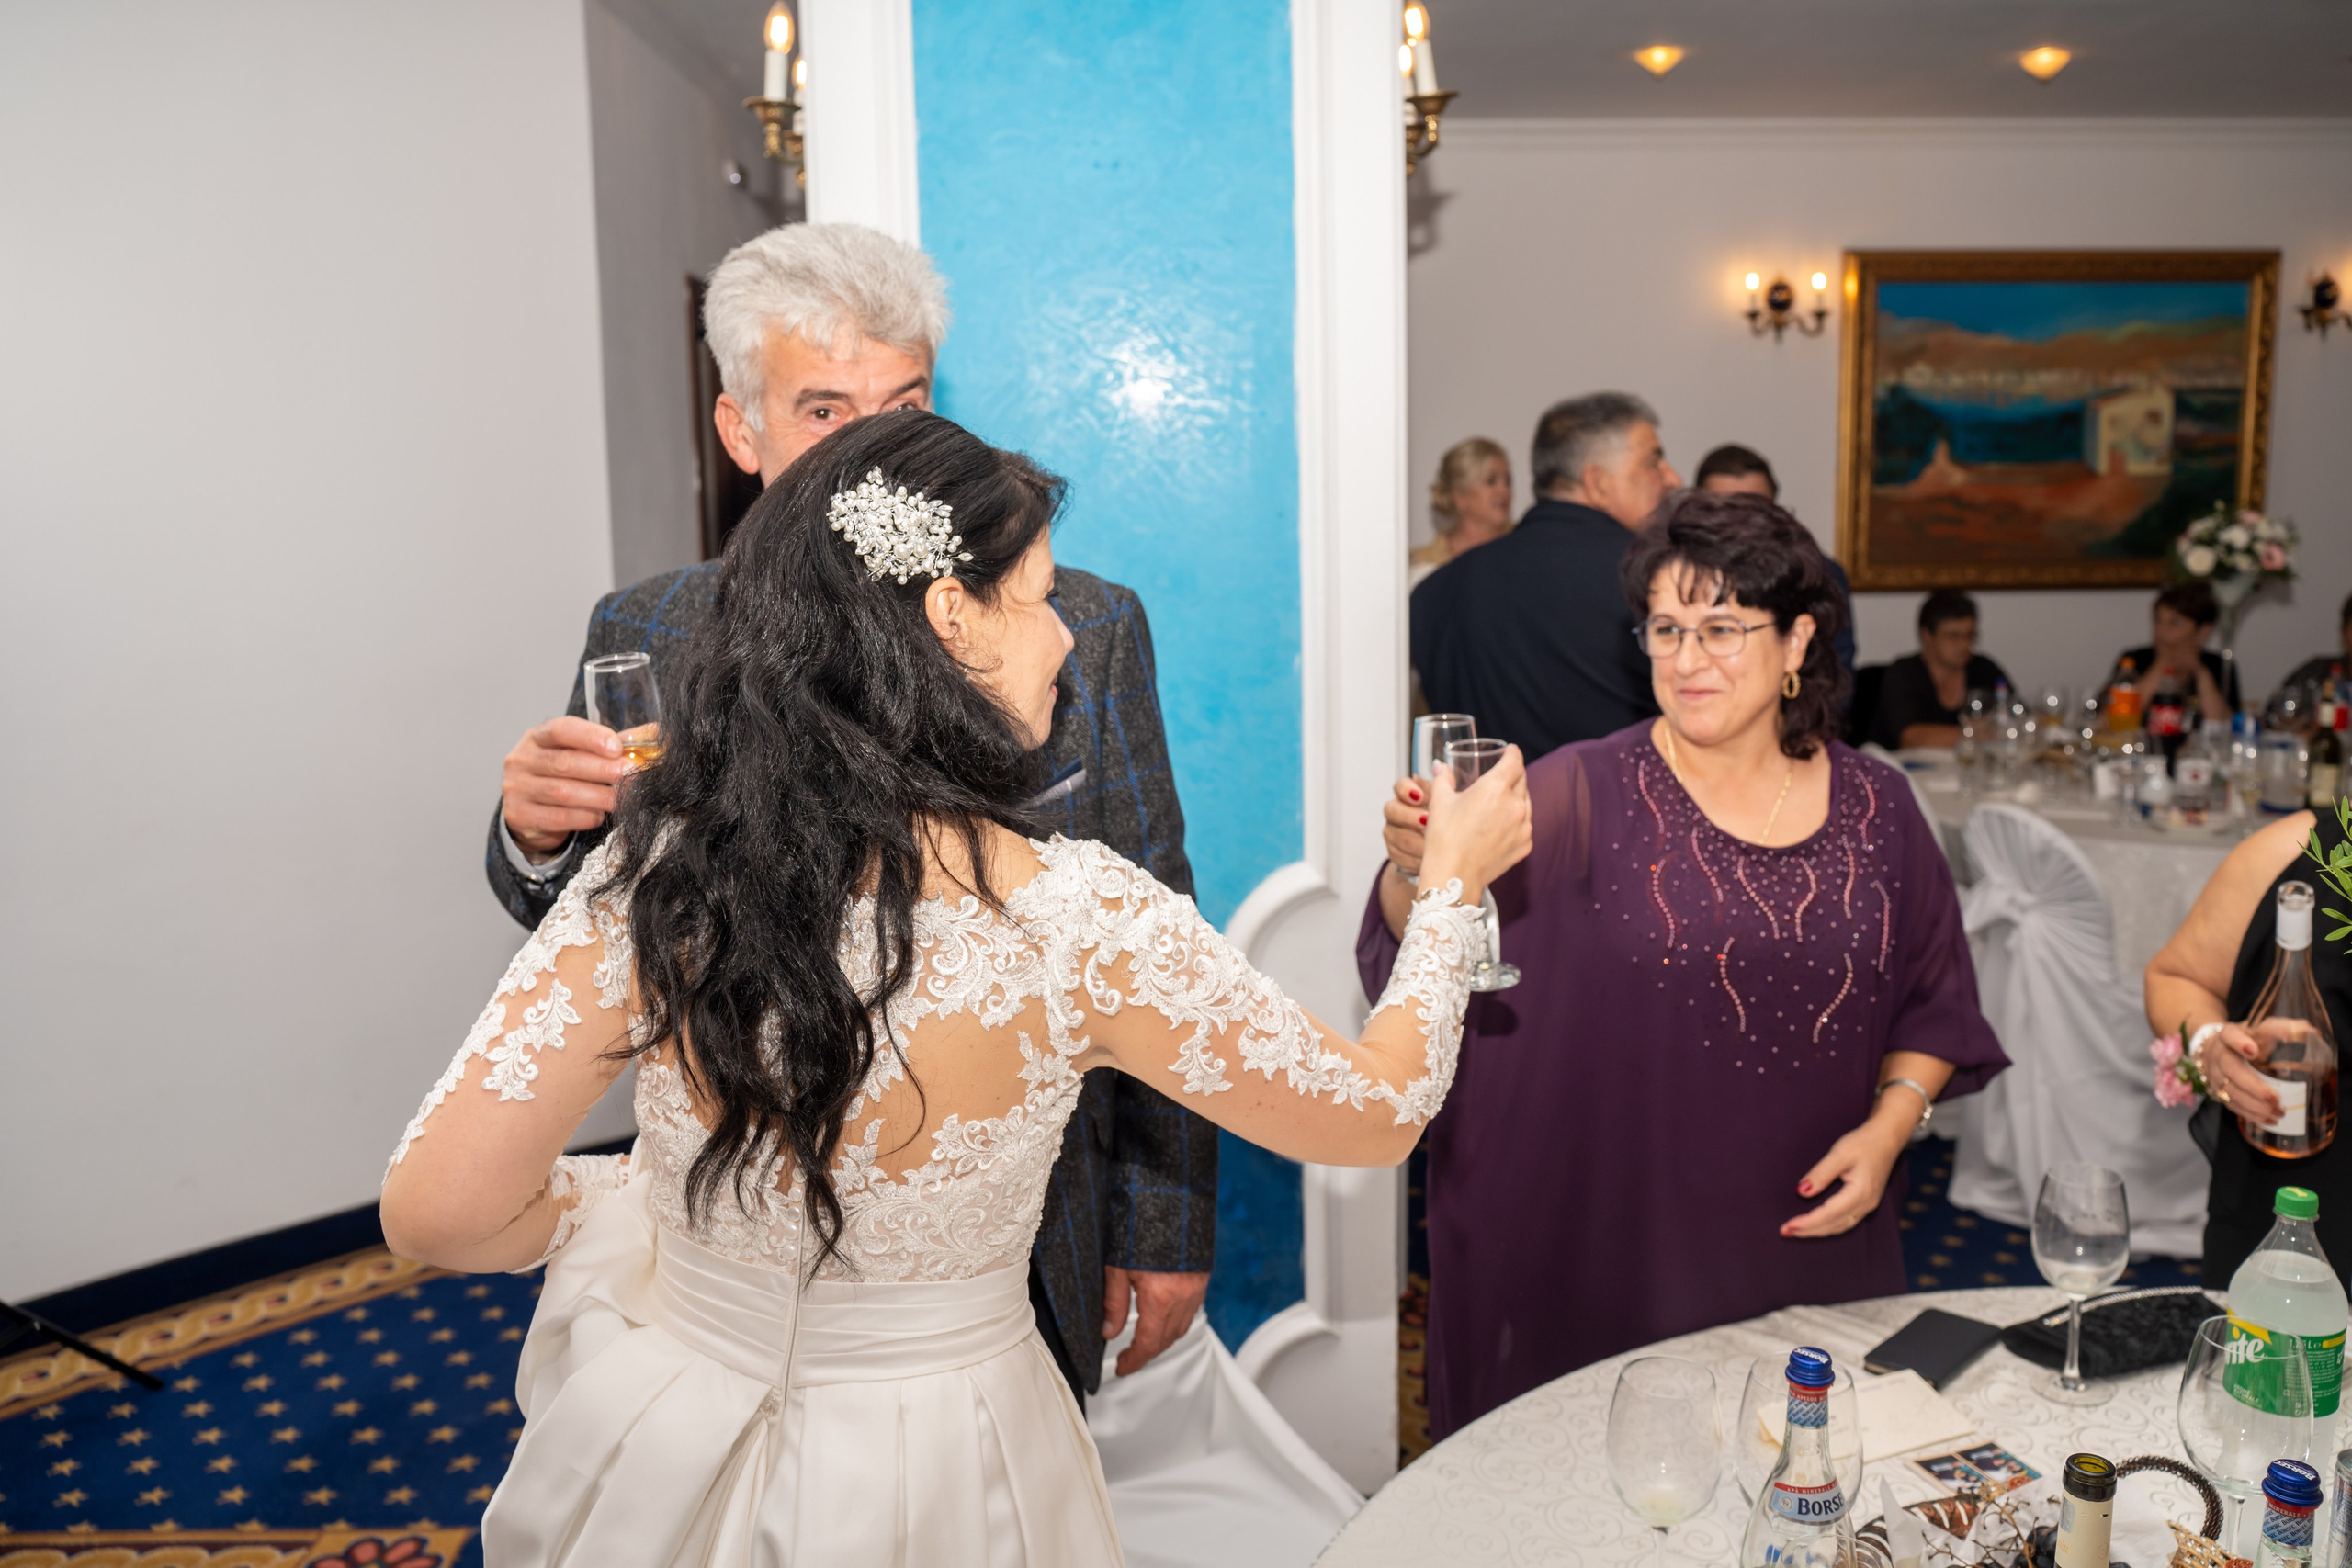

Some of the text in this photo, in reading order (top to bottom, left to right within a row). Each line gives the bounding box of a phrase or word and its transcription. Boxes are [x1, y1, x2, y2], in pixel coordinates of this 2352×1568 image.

[2272, 1460, 2316, 1481] BORSEC
[1797, 1492, 1845, 1517] BORSE
[2268, 1502, 2301, 1518] MINERALE
